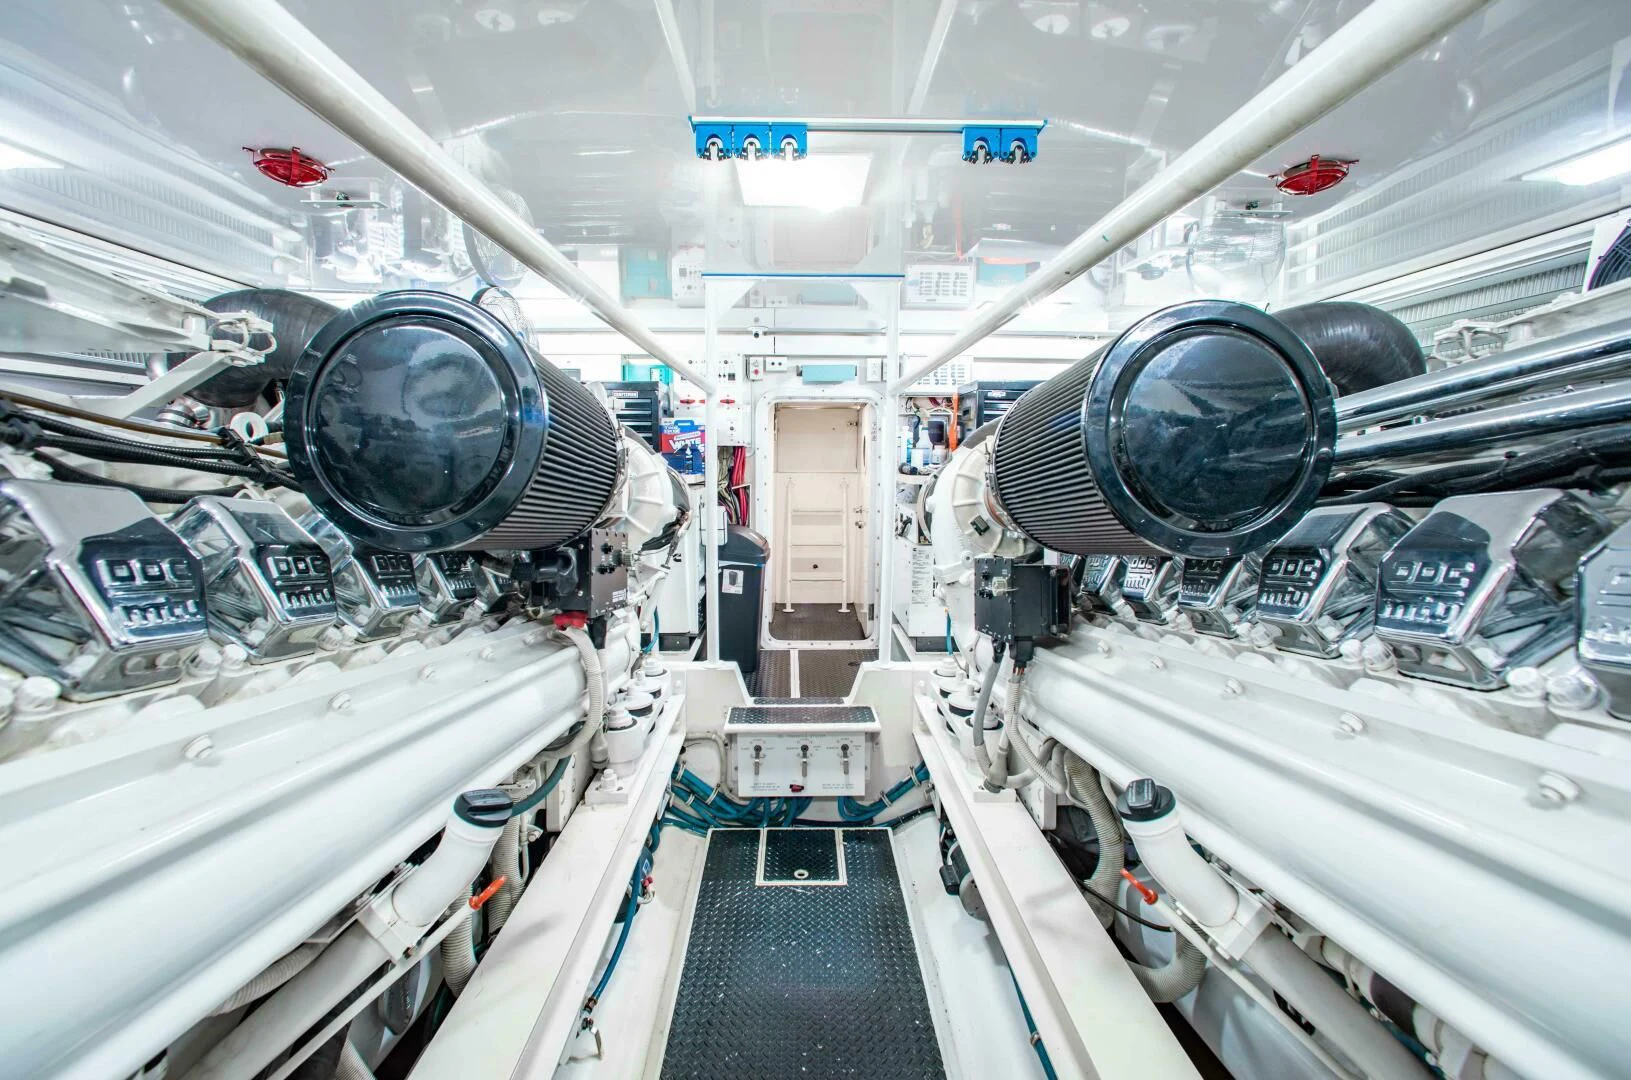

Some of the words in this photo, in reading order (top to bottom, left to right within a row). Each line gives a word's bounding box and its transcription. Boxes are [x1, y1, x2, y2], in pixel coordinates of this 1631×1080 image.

[95, 558, 195, 588] DDC
[266, 555, 327, 579] DDC
[1129, 556, 1158, 569] DDC
[1266, 557, 1322, 580] DDC
[1386, 560, 1475, 588] DDC
